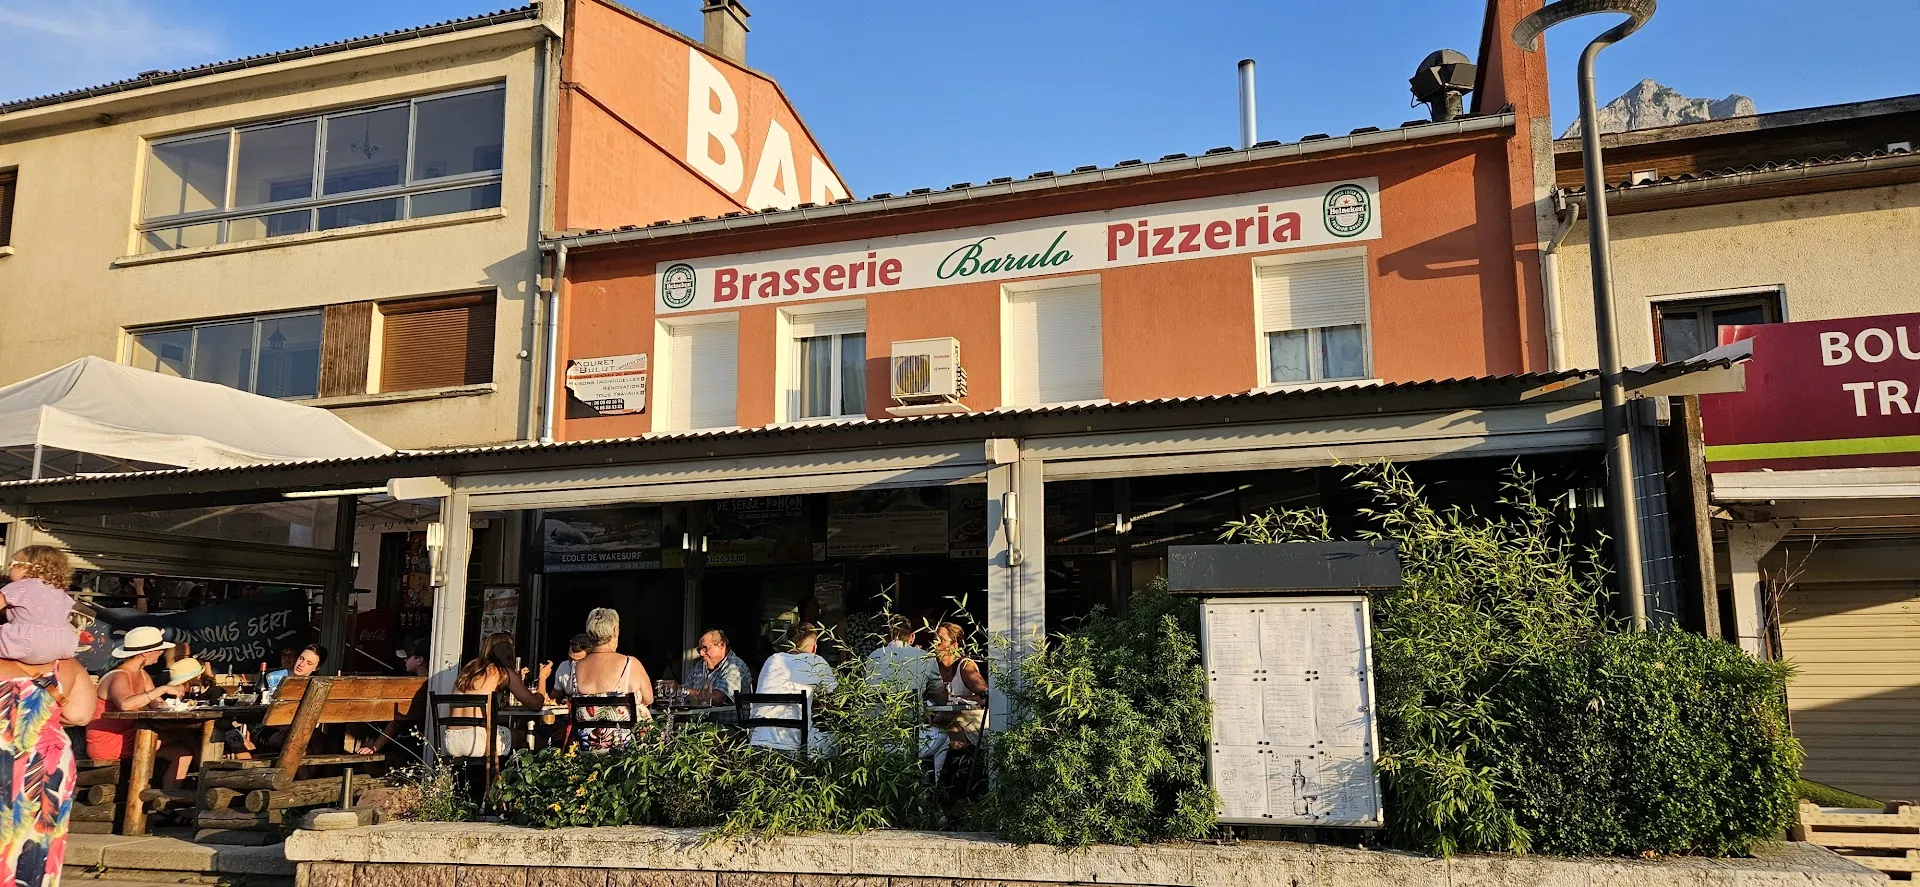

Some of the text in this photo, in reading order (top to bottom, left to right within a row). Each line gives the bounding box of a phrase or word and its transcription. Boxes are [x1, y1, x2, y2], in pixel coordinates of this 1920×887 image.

[1330, 206, 1364, 215] Heineken
[713, 205, 1302, 303] Brasserie Barulo Pizzeria
[666, 281, 691, 290] Heineken
[580, 365, 616, 373] BULUT
[1842, 379, 1920, 418] TR
[561, 551, 643, 563] ECOLE DE WAKESURF
[195, 621, 241, 643] VOUS
[247, 608, 294, 636] SERT
